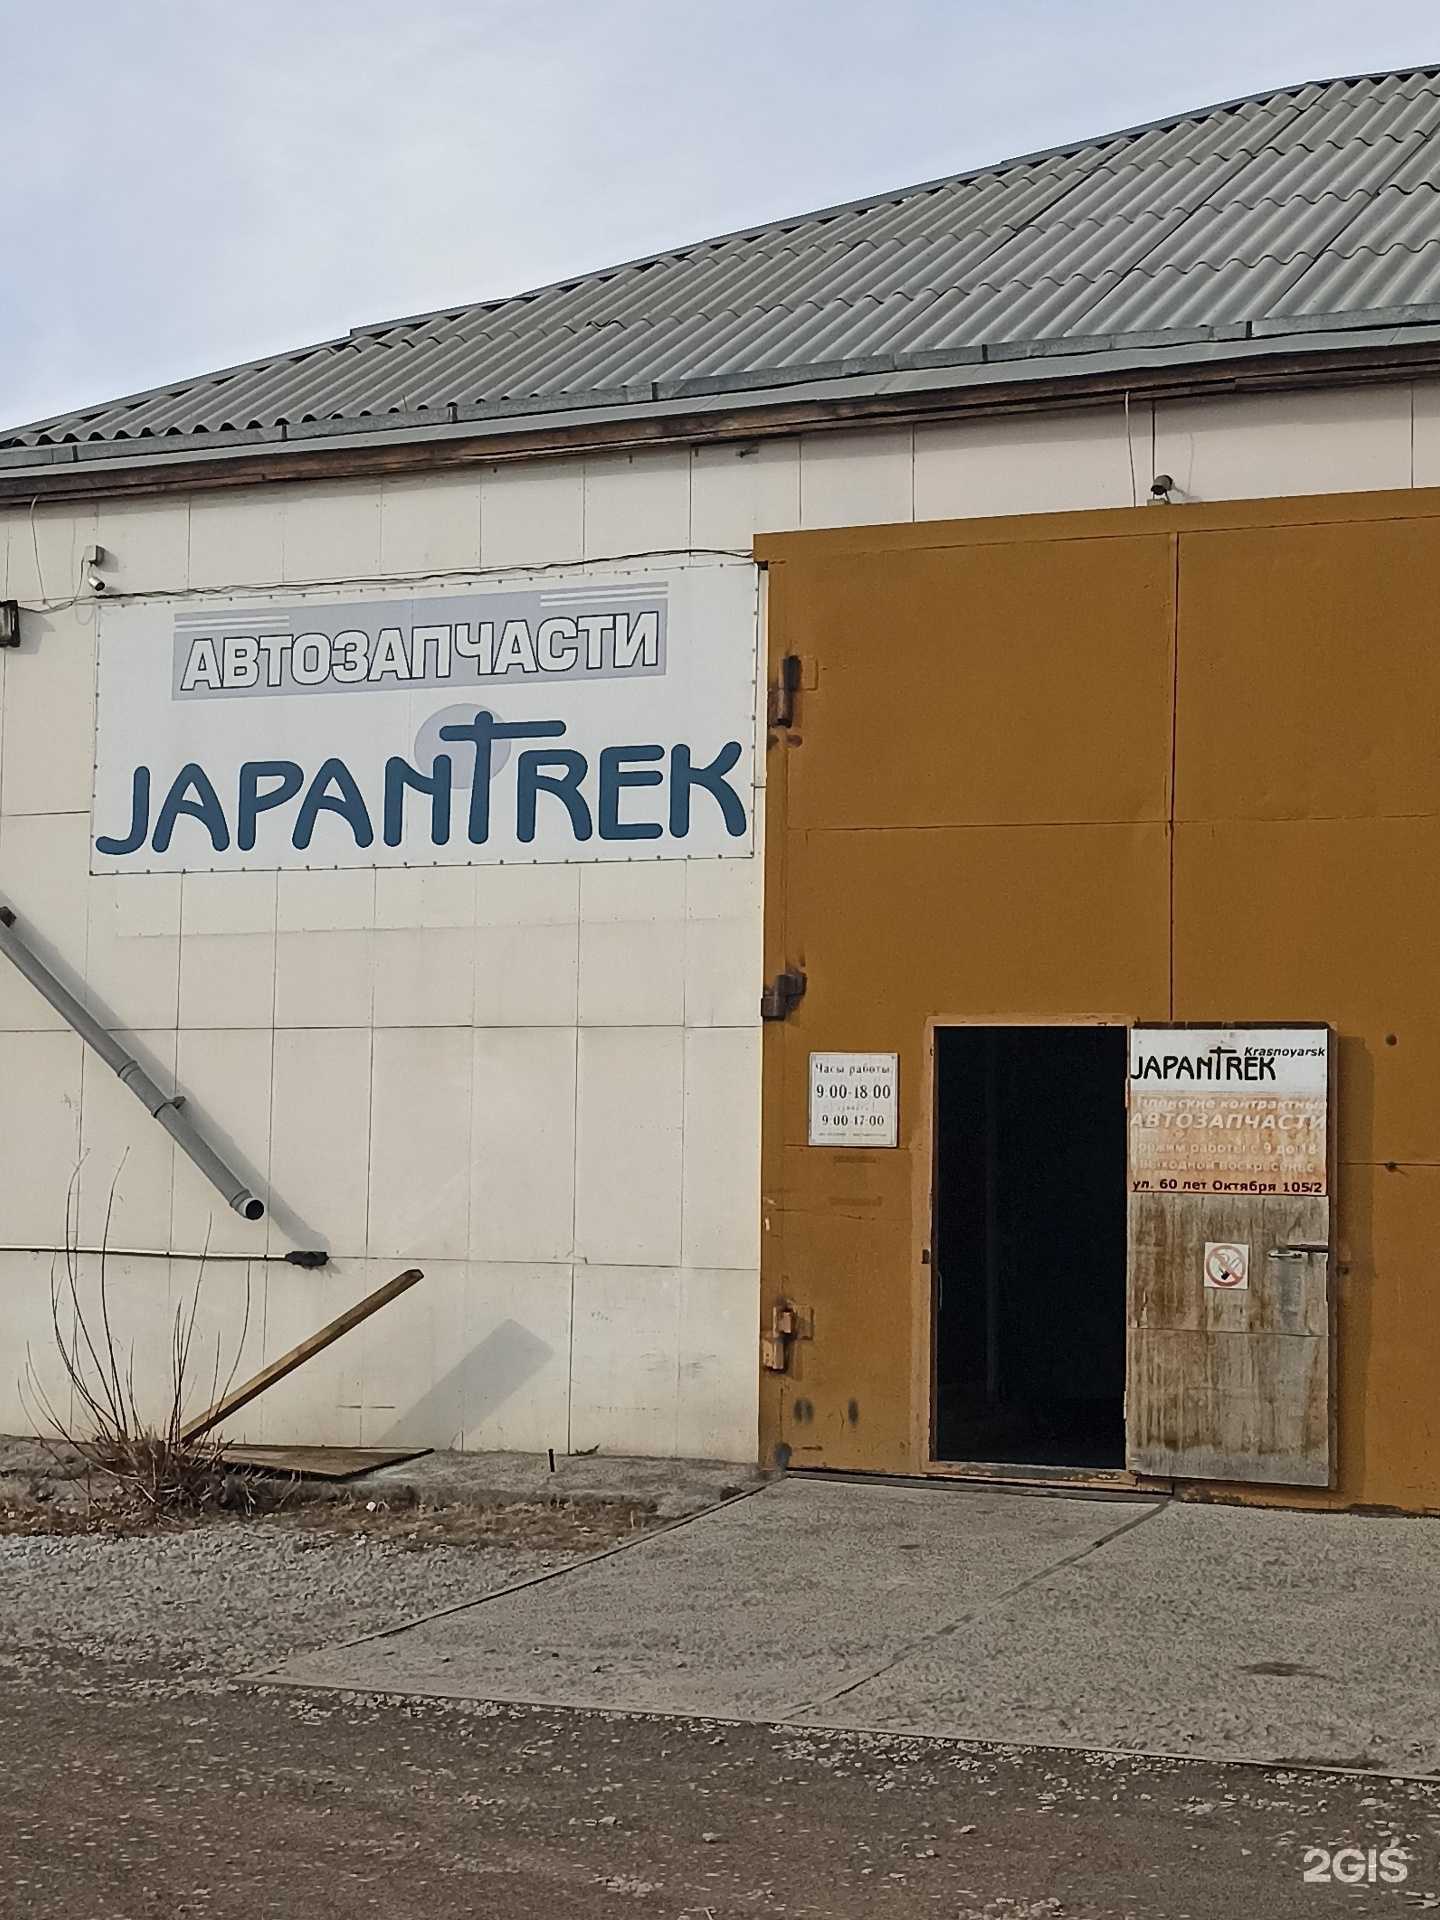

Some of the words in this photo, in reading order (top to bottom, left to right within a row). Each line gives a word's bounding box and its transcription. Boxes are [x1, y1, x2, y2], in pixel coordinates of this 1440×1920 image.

[181, 611, 659, 690] АВТОЗАПЧАСТИ
[95, 711, 747, 855] JAPANTREK
[1244, 1046, 1325, 1057] Krasnoyarsk
[815, 1063, 844, 1073] Часы
[849, 1063, 889, 1076] работы
[1130, 1046, 1276, 1081] JAPANTREK
[1130, 1112, 1326, 1130] АВТОЗАПЧАСТИ
[1132, 1180, 1153, 1191] ул.
[1159, 1179, 1178, 1189] 60
[1182, 1181, 1207, 1190] лет
[1212, 1180, 1276, 1194] Октября
[1283, 1182, 1322, 1193] 105/2
